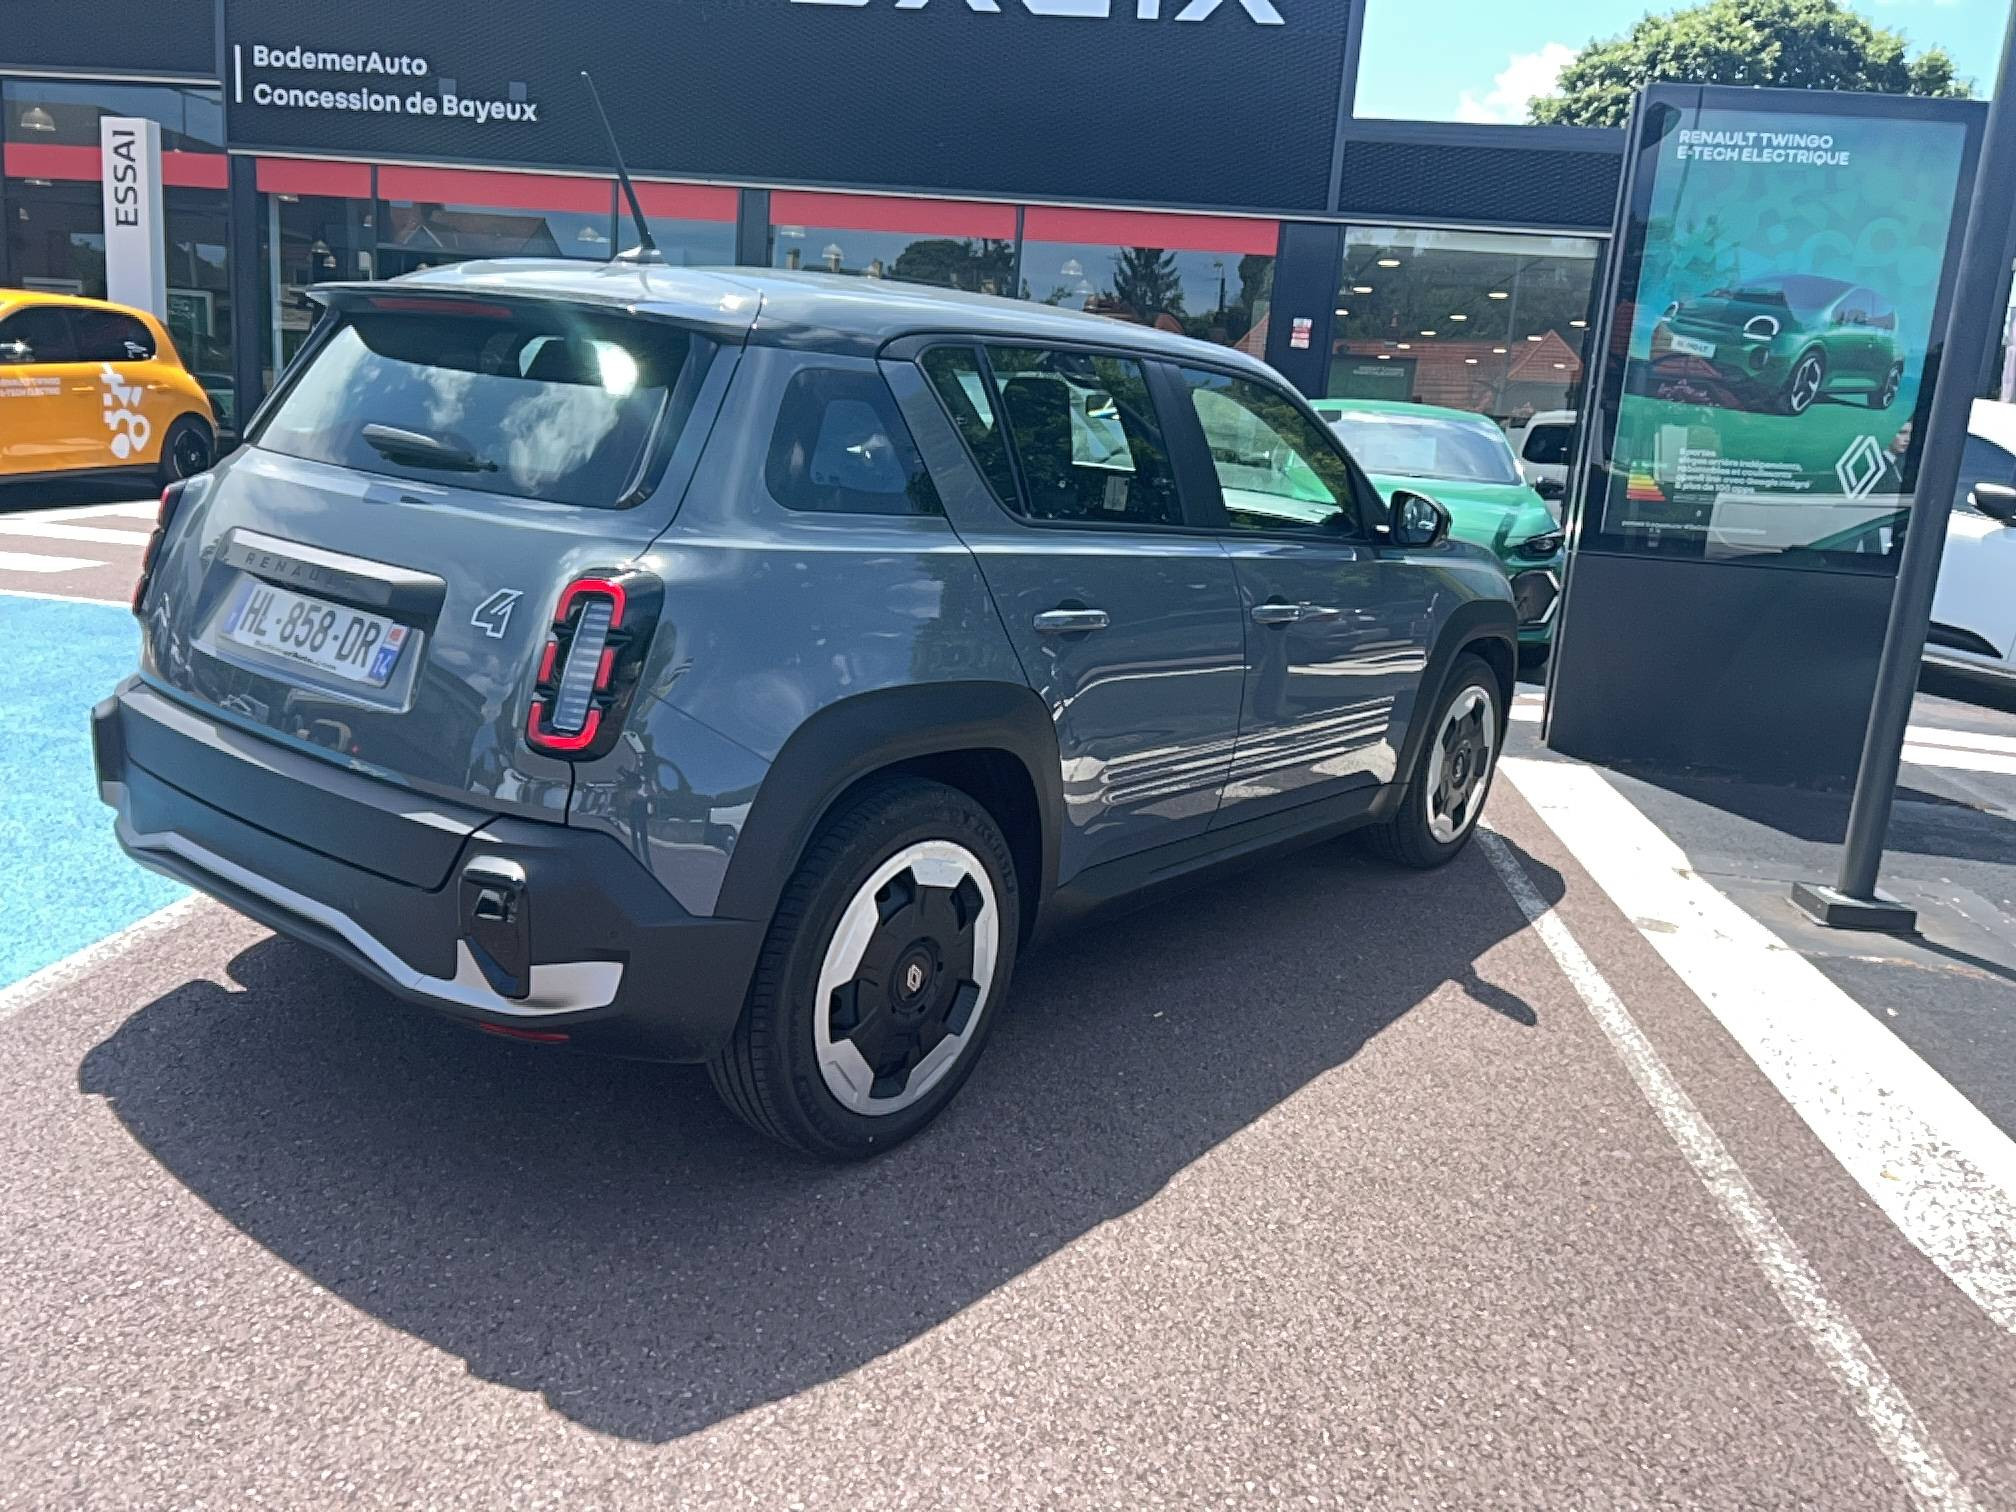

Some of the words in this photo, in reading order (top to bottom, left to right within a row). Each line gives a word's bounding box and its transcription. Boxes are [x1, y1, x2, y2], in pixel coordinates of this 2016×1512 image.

[252, 44, 428, 77] BodemerAuto
[252, 82, 401, 113] Concession
[405, 91, 438, 116] de
[441, 95, 538, 124] Bayeux
[1678, 129, 1757, 146] RENAULT
[1759, 132, 1834, 150] TWINGO
[1676, 145, 1739, 161] E-TECH
[1740, 149, 1850, 167] ELECTRIQUE
[112, 130, 138, 227] ESSAI
[371, 651, 393, 678] 14
